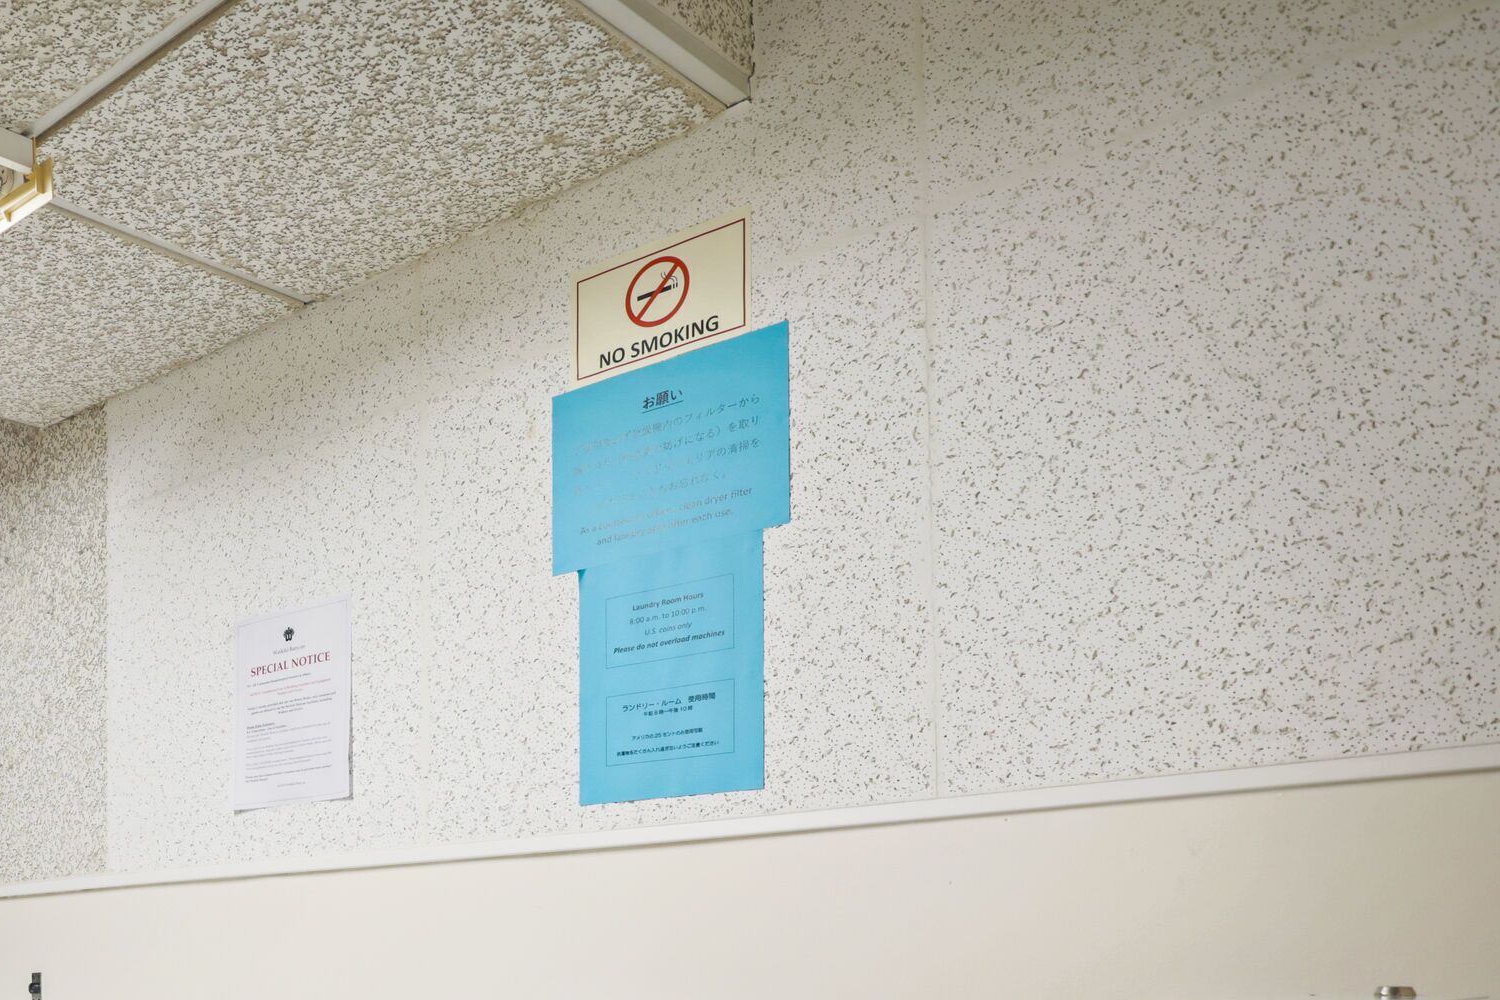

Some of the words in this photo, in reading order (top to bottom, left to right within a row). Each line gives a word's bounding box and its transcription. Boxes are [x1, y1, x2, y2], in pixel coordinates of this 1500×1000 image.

[599, 347, 625, 369] NO
[631, 315, 719, 359] SMOKING
[642, 389, 683, 410] お願い
[704, 493, 728, 505] dryer
[731, 487, 753, 499] filter
[596, 535, 612, 546] and
[691, 511, 712, 523] each
[632, 600, 660, 611] Laundry
[661, 597, 682, 605] Room
[683, 592, 704, 601] Hours
[677, 621, 692, 630] only
[613, 645, 635, 654] Please
[636, 643, 645, 651] do
[646, 641, 659, 649] not
[659, 635, 691, 646] overload
[691, 630, 725, 641] machines
[250, 660, 289, 677] SPECIAL
[291, 651, 331, 668] NOTICE
